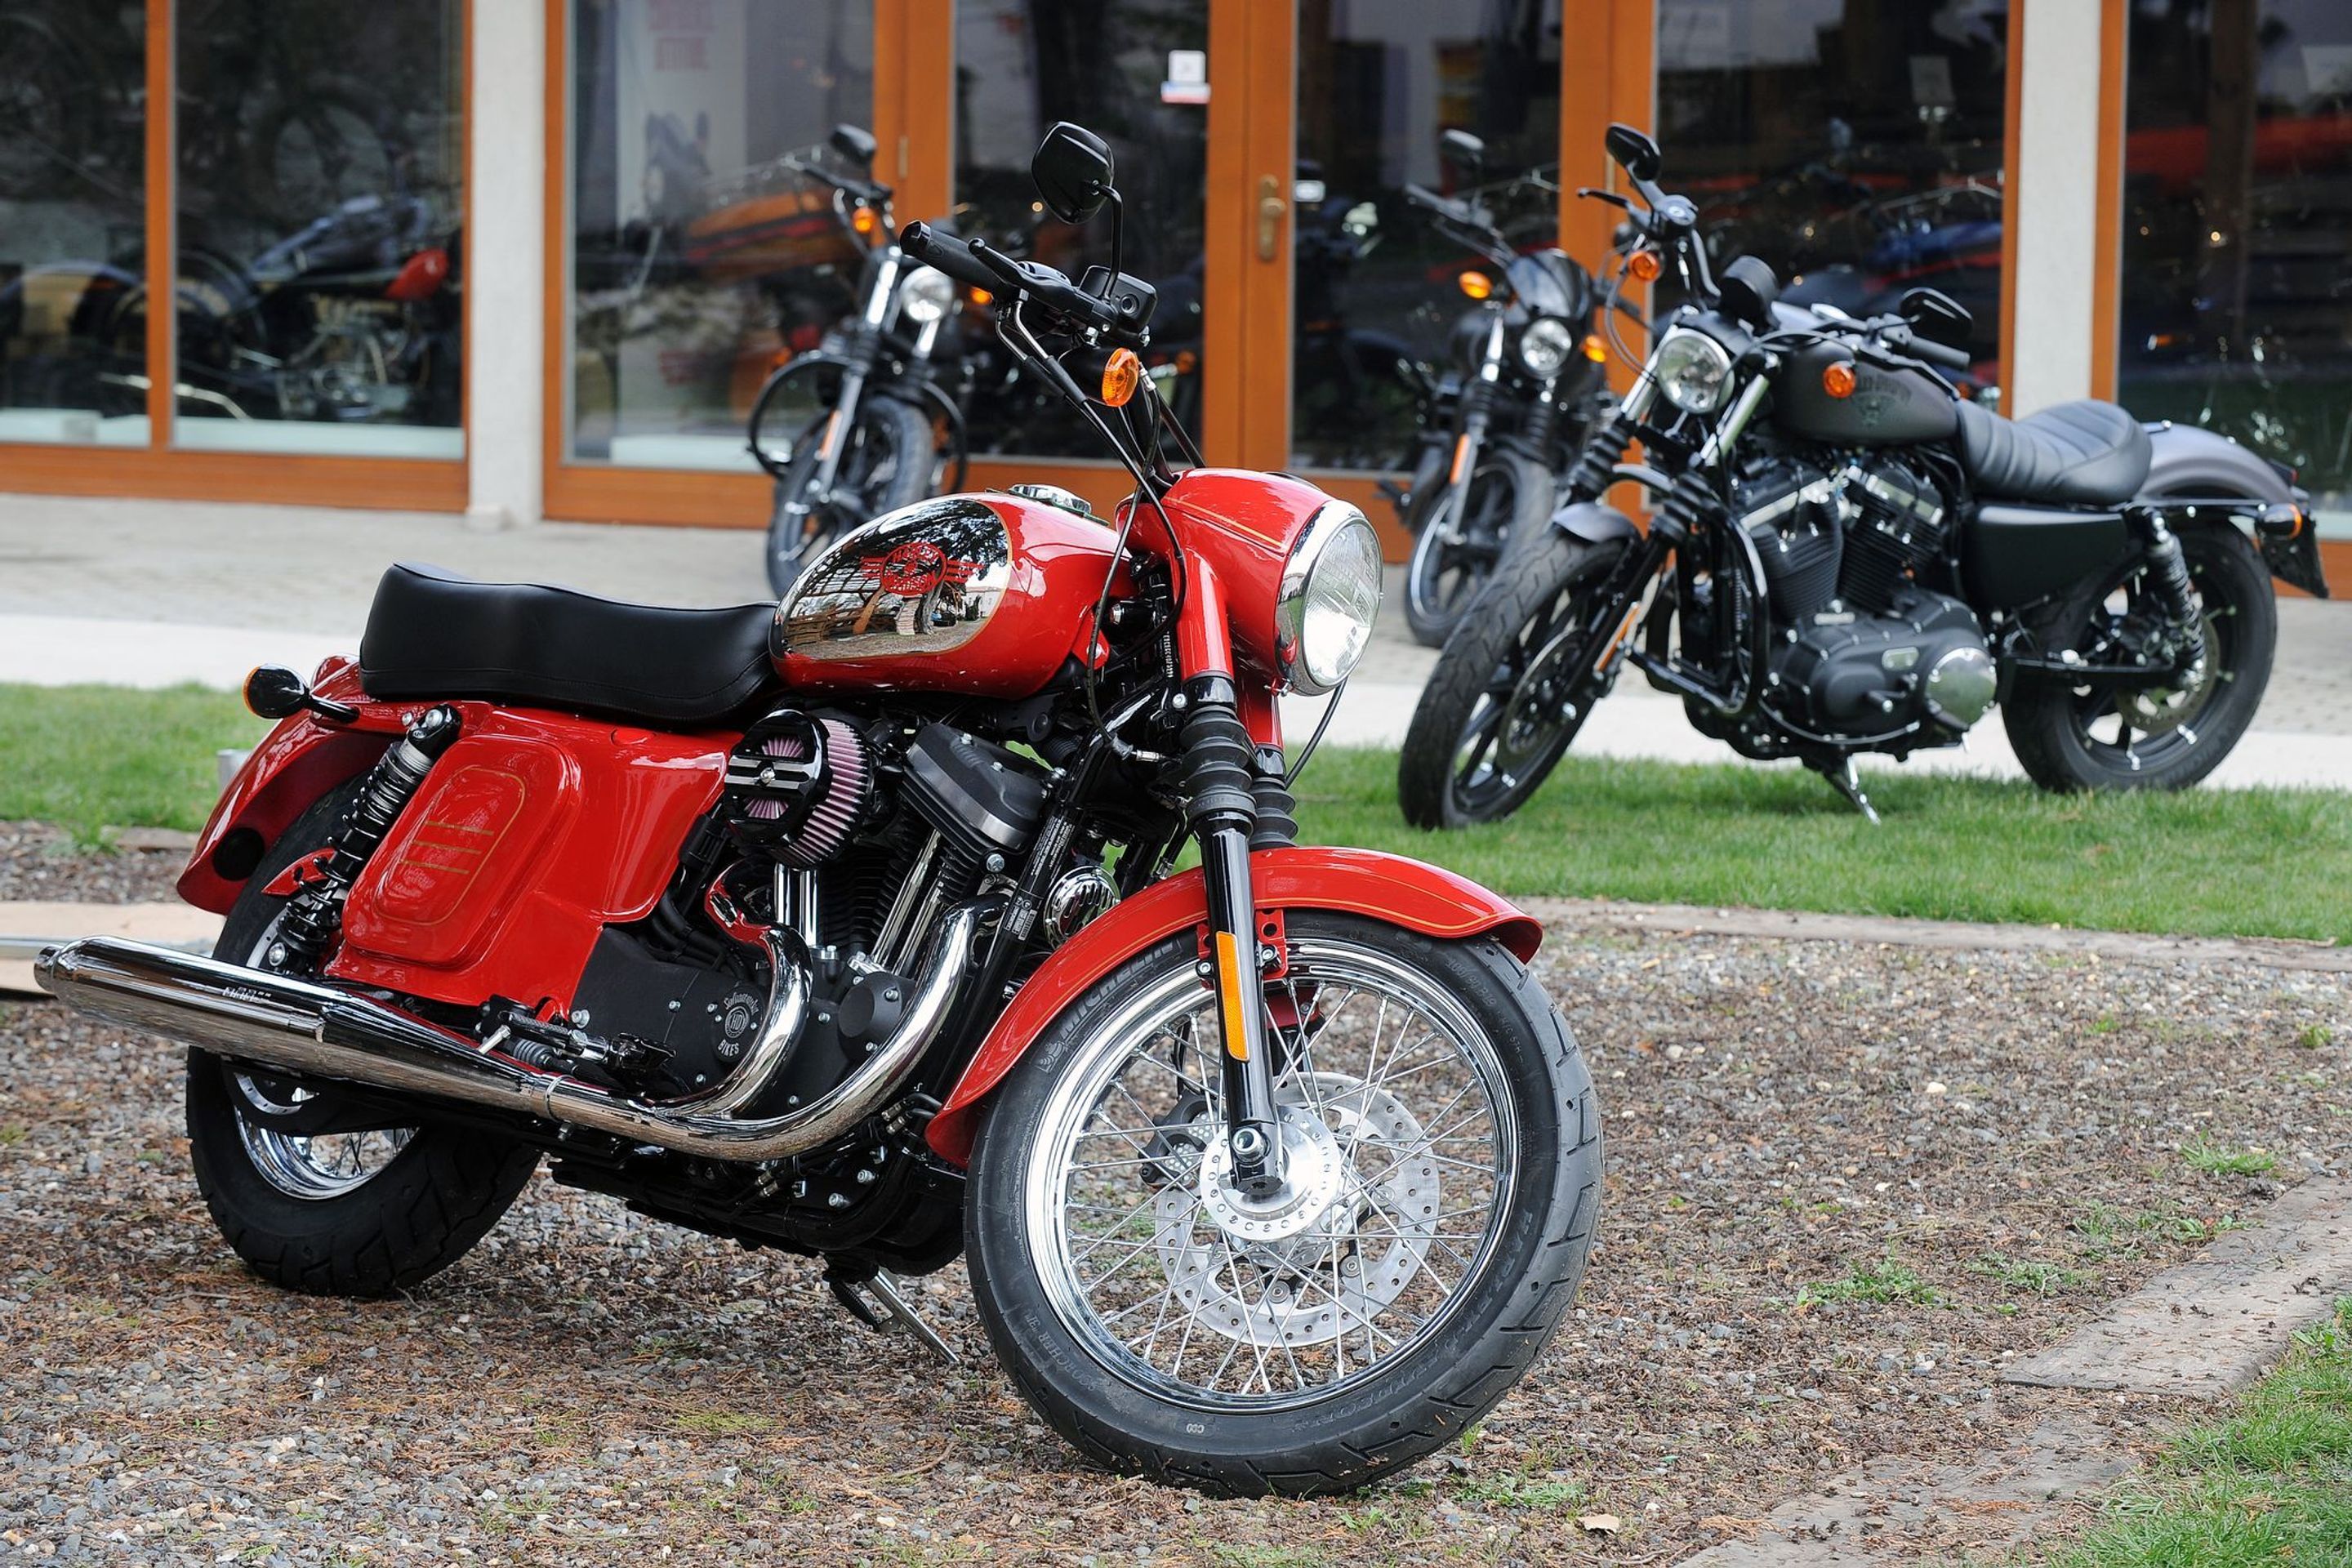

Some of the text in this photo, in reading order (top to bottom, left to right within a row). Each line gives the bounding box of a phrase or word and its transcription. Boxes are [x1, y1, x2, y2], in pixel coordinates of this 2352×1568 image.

[1059, 942, 1174, 1040] MICHELIN
[718, 1040, 739, 1057] BIKES
[1038, 1330, 1098, 1392] SCORCHER
